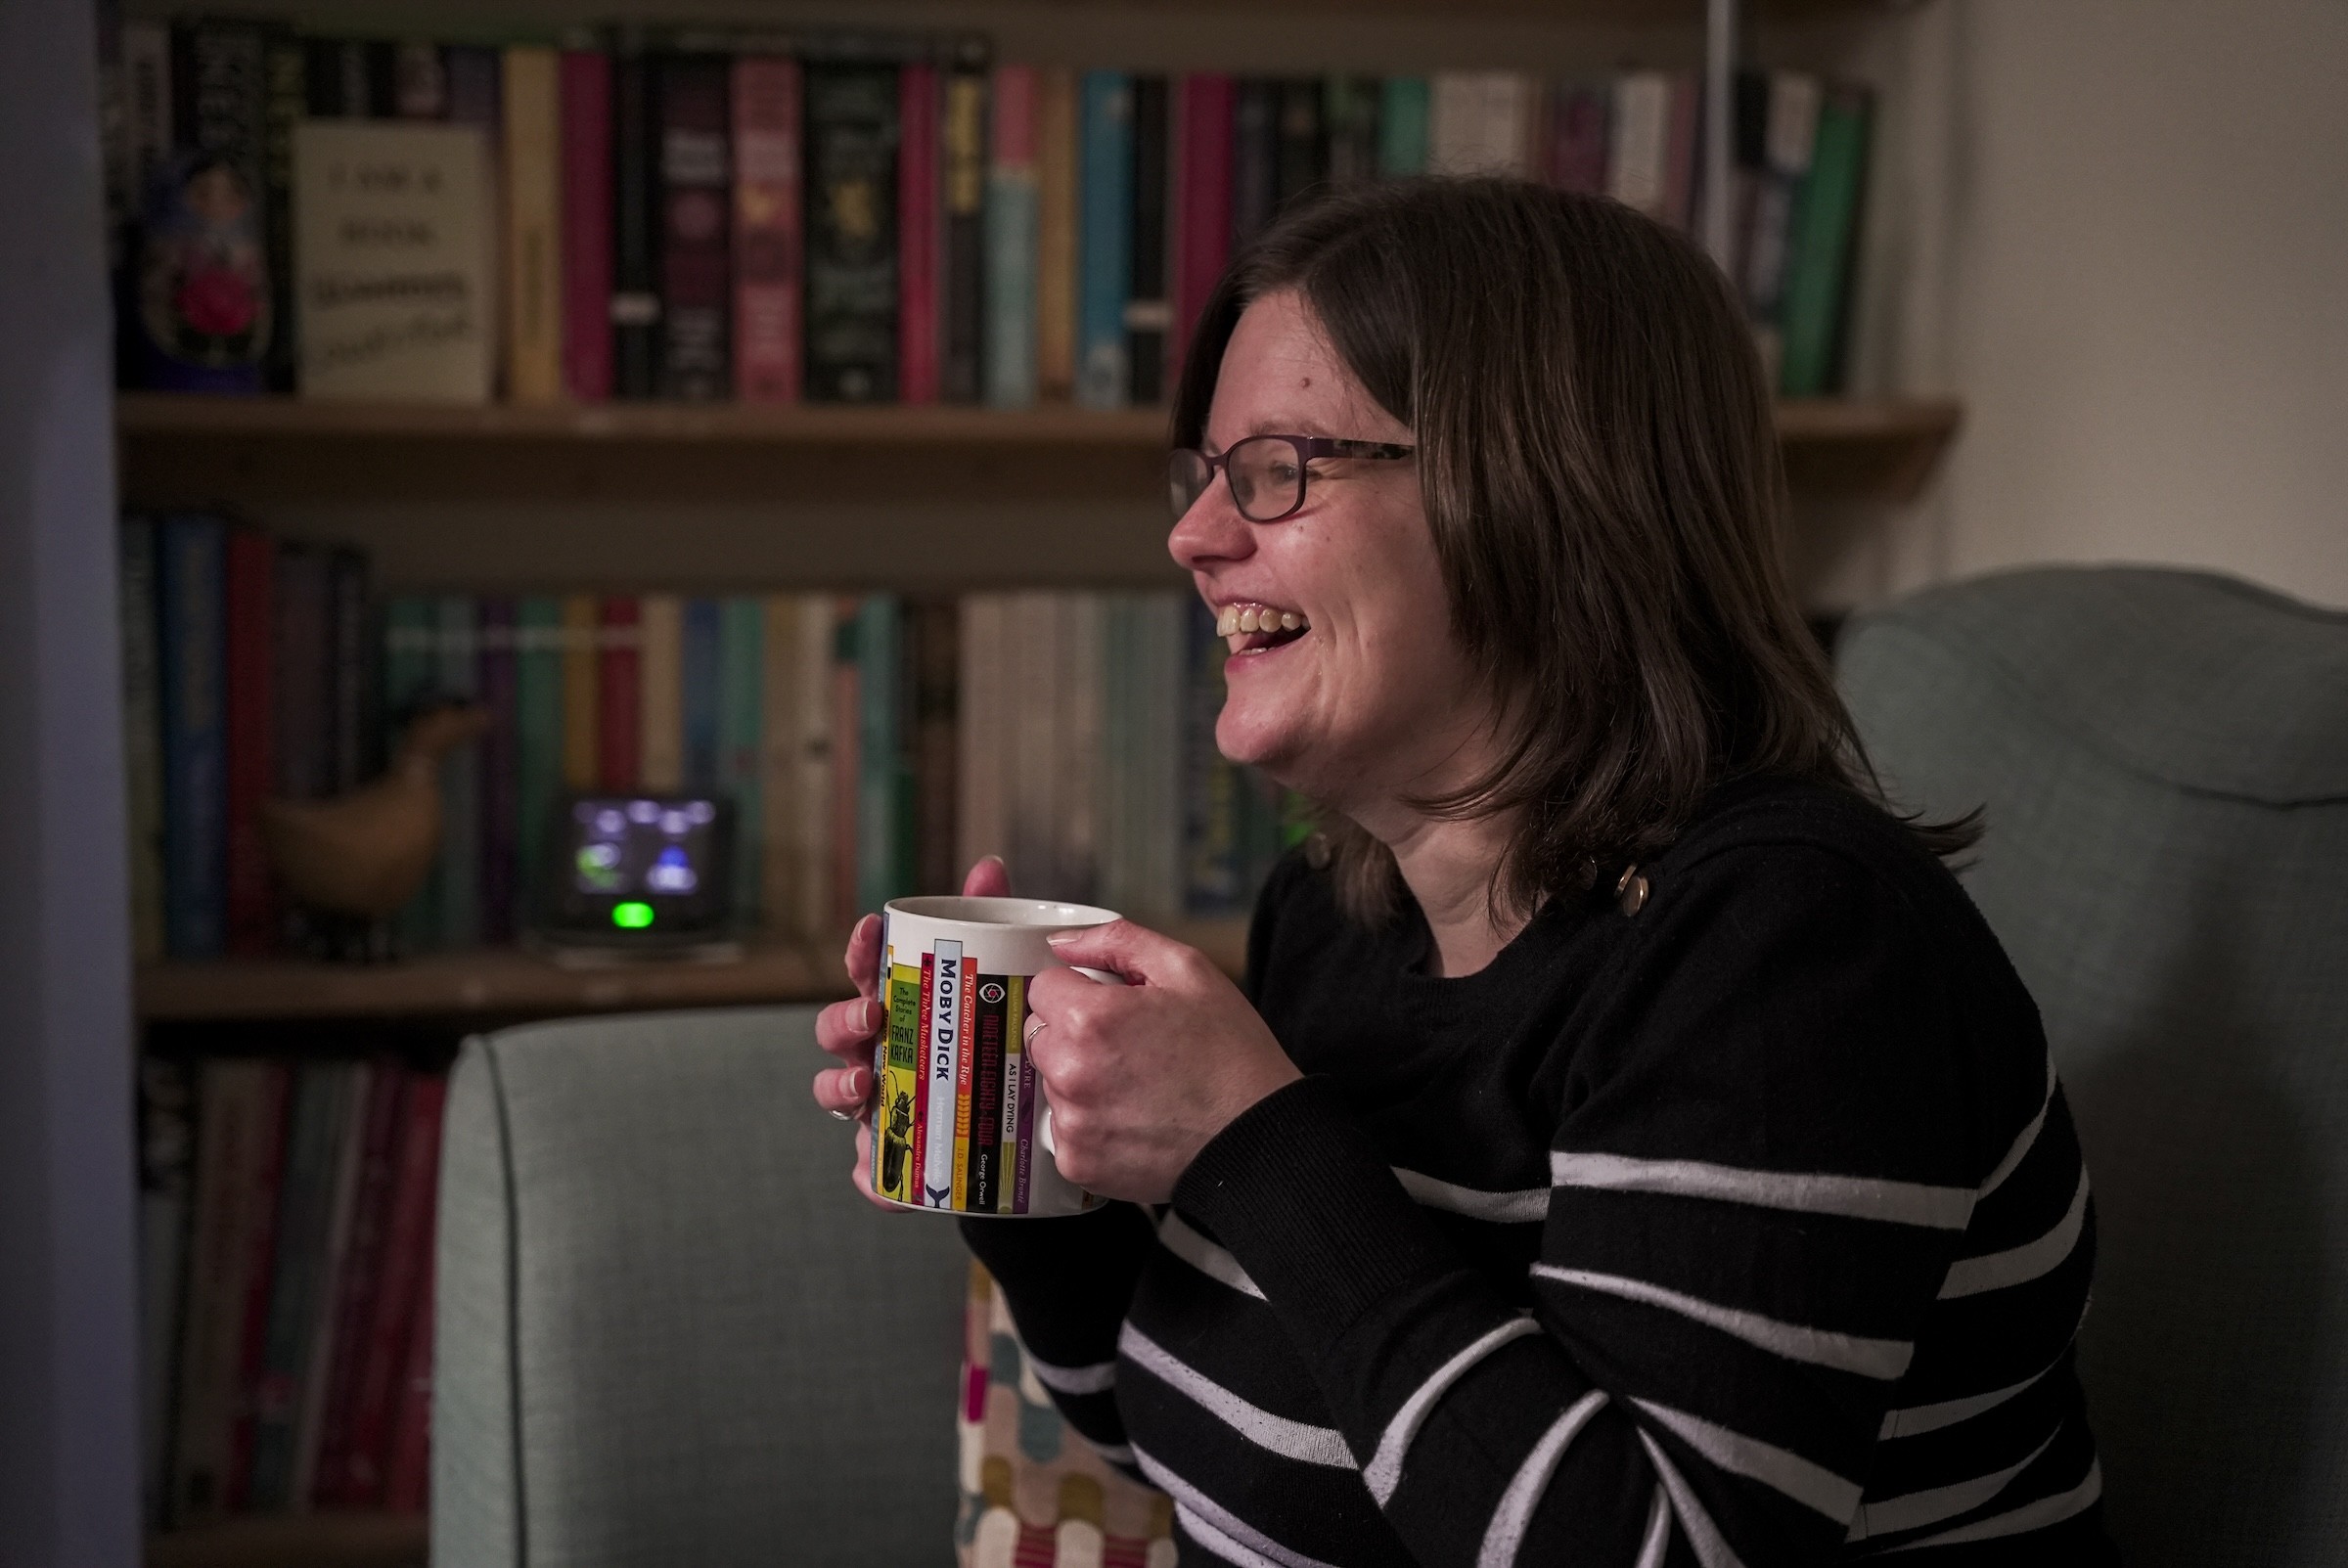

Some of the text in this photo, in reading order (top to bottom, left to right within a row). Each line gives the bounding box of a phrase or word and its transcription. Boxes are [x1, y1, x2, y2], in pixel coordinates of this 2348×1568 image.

[893, 995, 916, 1007] Complete
[899, 987, 909, 996] The
[895, 1005, 912, 1015] Stories
[919, 969, 931, 1081] The Three Musketeers
[936, 959, 957, 1082] MOBY DICK
[891, 1024, 914, 1045] FRANZ
[959, 973, 973, 1086] The Catcher in the Rye
[981, 1014, 999, 1067] NINETEEN
[890, 1044, 914, 1064] KAFKA
[1009, 1063, 1017, 1076] AS
[1008, 1085, 1016, 1101] LAY
[934, 1096, 945, 1141] Herman
[1006, 1102, 1016, 1134] DYING
[915, 1123, 924, 1161] Alexandre
[1019, 1139, 1029, 1175] Charlotte
[955, 1163, 964, 1201] SALINGER
[978, 1154, 988, 1205] George Orwell
